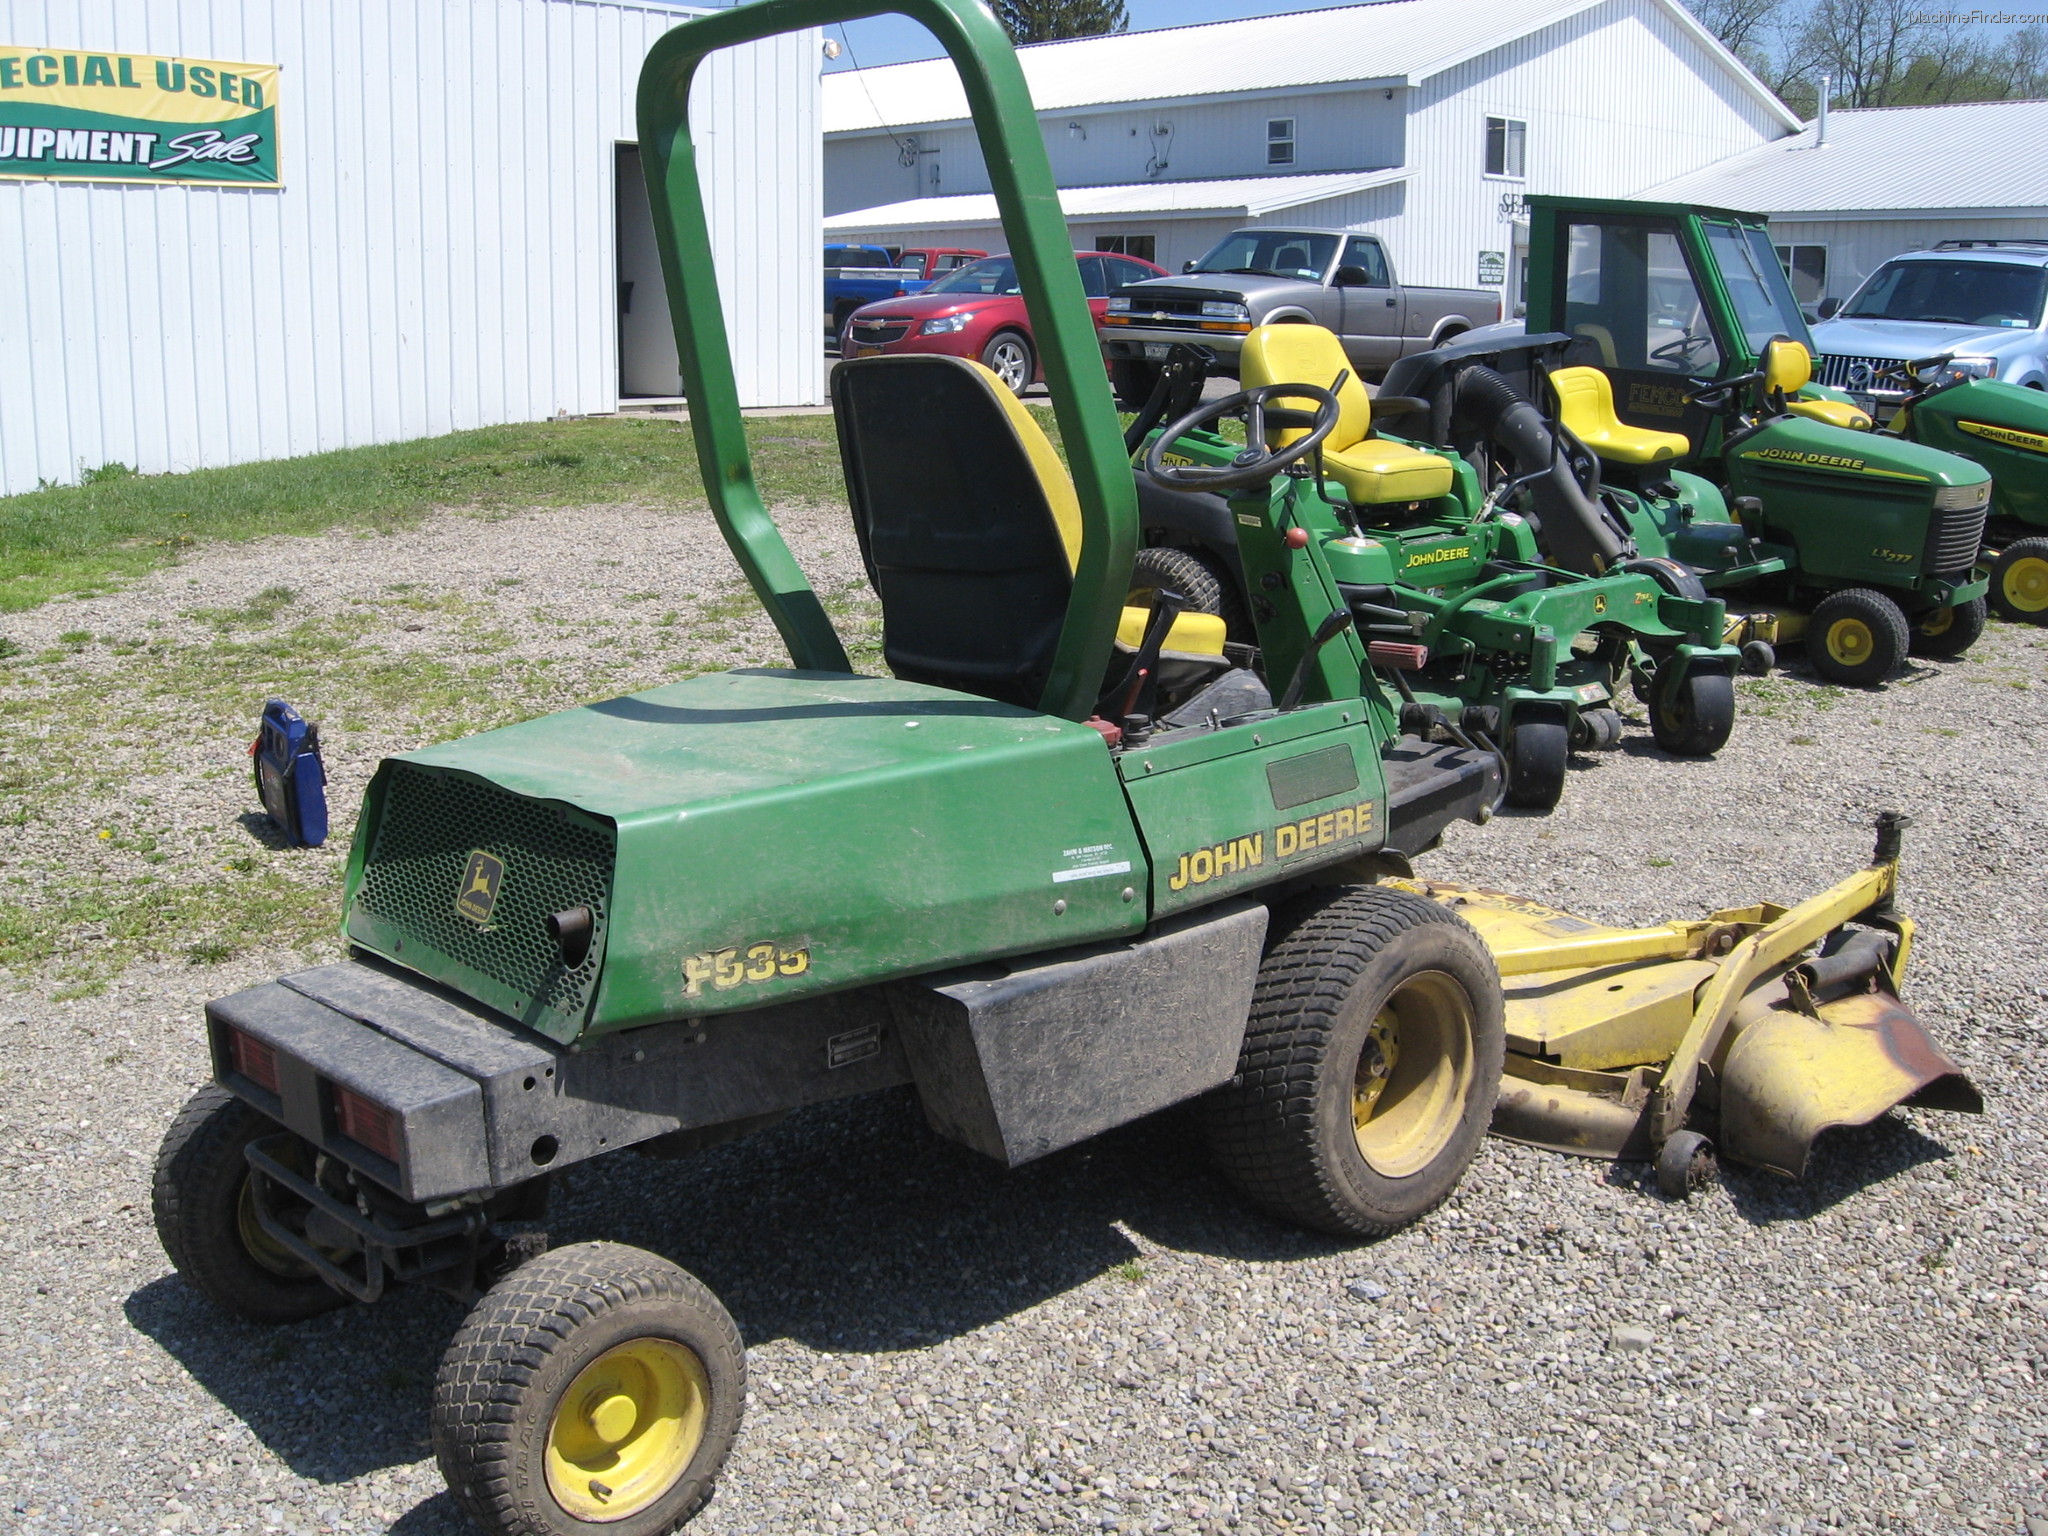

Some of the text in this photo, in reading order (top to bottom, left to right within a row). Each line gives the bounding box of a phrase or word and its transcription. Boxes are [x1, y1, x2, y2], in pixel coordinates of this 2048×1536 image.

[0, 55, 264, 110] ECIAL USED
[149, 130, 260, 171] Sale
[1976, 427, 2044, 447] JOHN DEERE
[1759, 448, 1865, 470] JOHN DEERE
[1406, 547, 1470, 568] JOHN DEERE
[1871, 548, 1914, 563] LX277
[1169, 801, 1374, 891] JOHN DEERE
